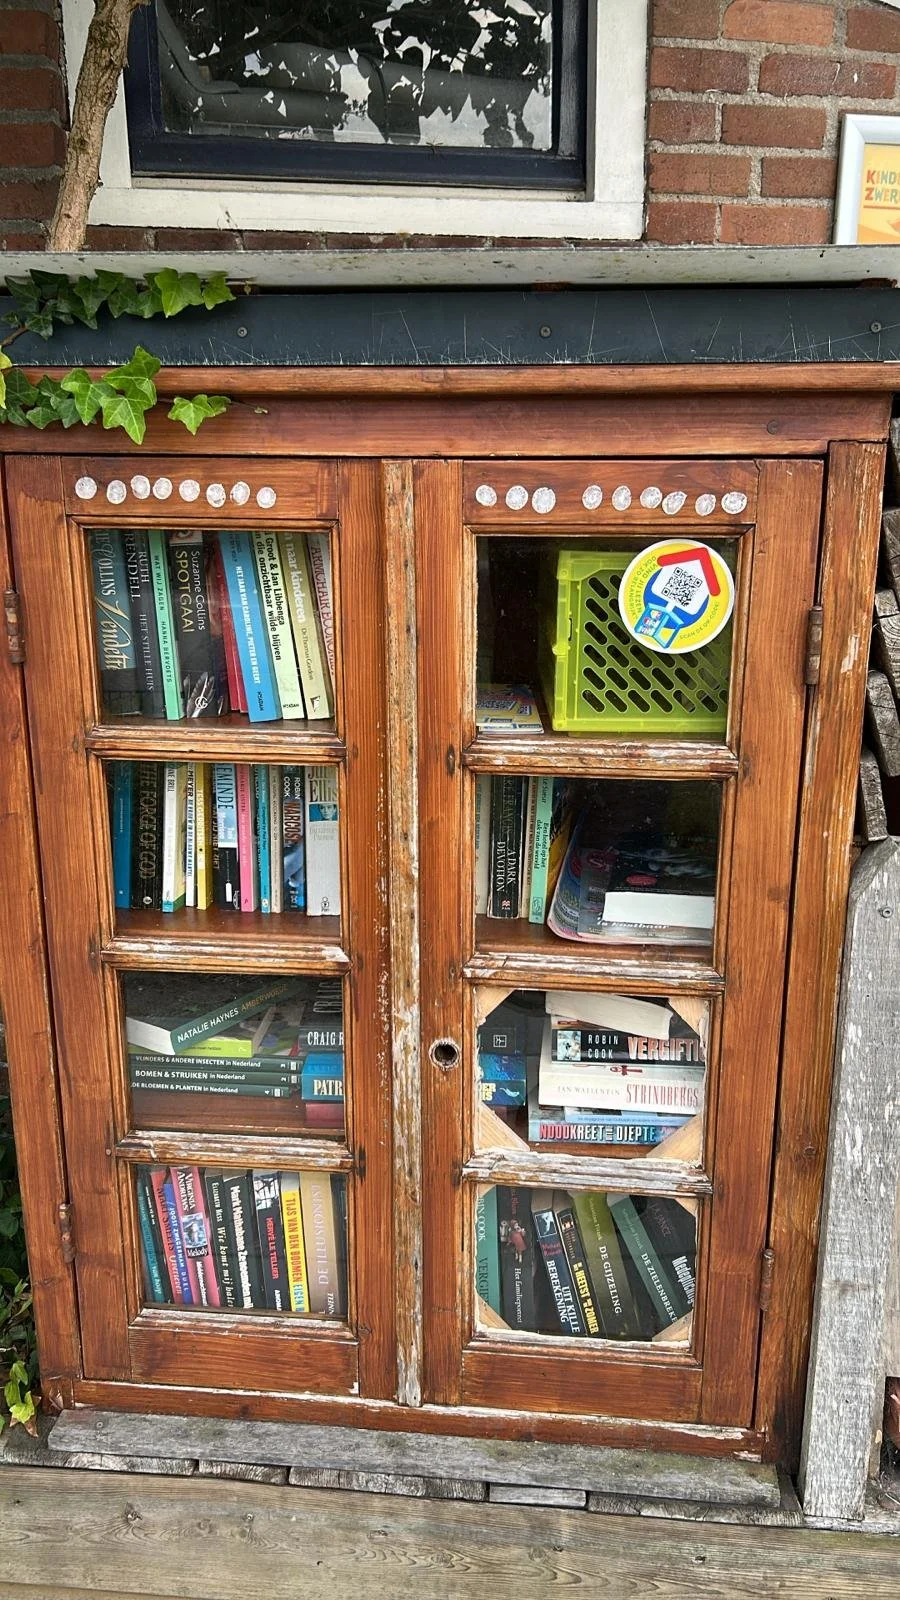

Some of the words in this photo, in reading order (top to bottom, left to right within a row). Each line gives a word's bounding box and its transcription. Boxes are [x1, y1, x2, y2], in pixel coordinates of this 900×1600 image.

[255, 540, 265, 554] die
[264, 536, 276, 561] Groot
[285, 542, 298, 570] naar
[88, 543, 116, 597] COLLINS
[121, 532, 143, 601] RENDELL
[136, 550, 151, 582] RUTH
[190, 550, 202, 592] Suzanne
[642, 562, 658, 578] VIND
[644, 555, 656, 568] OOK
[258, 556, 274, 608] onzichtbaar
[270, 571, 280, 585] Jan
[309, 545, 330, 609] ARMCHAIR
[174, 550, 195, 632] SPOTGAAI
[289, 570, 308, 621] kinderen
[195, 593, 207, 630] Collins
[271, 587, 286, 625] Libbenga
[138, 613, 147, 631] HET
[267, 609, 278, 631] wilde
[141, 634, 151, 665] STILLE
[270, 633, 282, 660] blijven
[162, 646, 171, 682] BERVOETS
[305, 658, 315, 680] Gordon
[144, 667, 154, 691] HUIS
[139, 762, 156, 787] THE
[216, 764, 233, 809] EMINDE
[310, 780, 337, 802] Ellis
[138, 832, 156, 848] OF
[506, 847, 516, 856] A
[138, 850, 155, 878] GOD
[494, 841, 506, 891] DEVOTION
[505, 858, 517, 884] DARK
[175, 1020, 210, 1043] NATALIE
[208, 1006, 239, 1027] HAYNES
[308, 1032, 336, 1046] CRAIG
[588, 1034, 619, 1044] ROBIN
[232, 1060, 261, 1068] Nederland
[588, 1048, 613, 1058] COOK
[626, 1084, 698, 1108] STRINDBERGS
[540, 1123, 604, 1141] NOODKREET
[616, 1126, 656, 1142] DIEPTE
[176, 1170, 190, 1211] ANDREWS
[183, 1172, 198, 1209] VIRGINIA
[229, 1184, 242, 1206] Mark
[169, 1206, 177, 1226] JOOST
[285, 1198, 296, 1216] TIJS
[216, 1226, 226, 1243] Wie
[232, 1206, 246, 1251] Mathabane
[287, 1218, 298, 1232] VAN
[477, 1215, 485, 1241] COOK
[172, 1227, 185, 1267] ZWAGERMAN
[187, 1248, 208, 1258] Melody
[268, 1241, 276, 1250] LE
[288, 1234, 300, 1249] DEN
[598, 1245, 608, 1260] DE
[218, 1244, 229, 1267] komt
[269, 1251, 279, 1279] TELLIER
[289, 1250, 303, 1282] BOOMEN
[640, 1252, 651, 1266] DE
[180, 1270, 189, 1291] DUEL
[221, 1268, 232, 1285] mij
[317, 1267, 329, 1284] DE
[601, 1260, 623, 1314] GIJZELING
[292, 1283, 304, 1305] EIGEN
[545, 1259, 570, 1323] BEREKENING
[561, 1285, 572, 1303] UIT
[566, 1304, 580, 1333] KILLE
[583, 1306, 599, 1333] ZOMER
